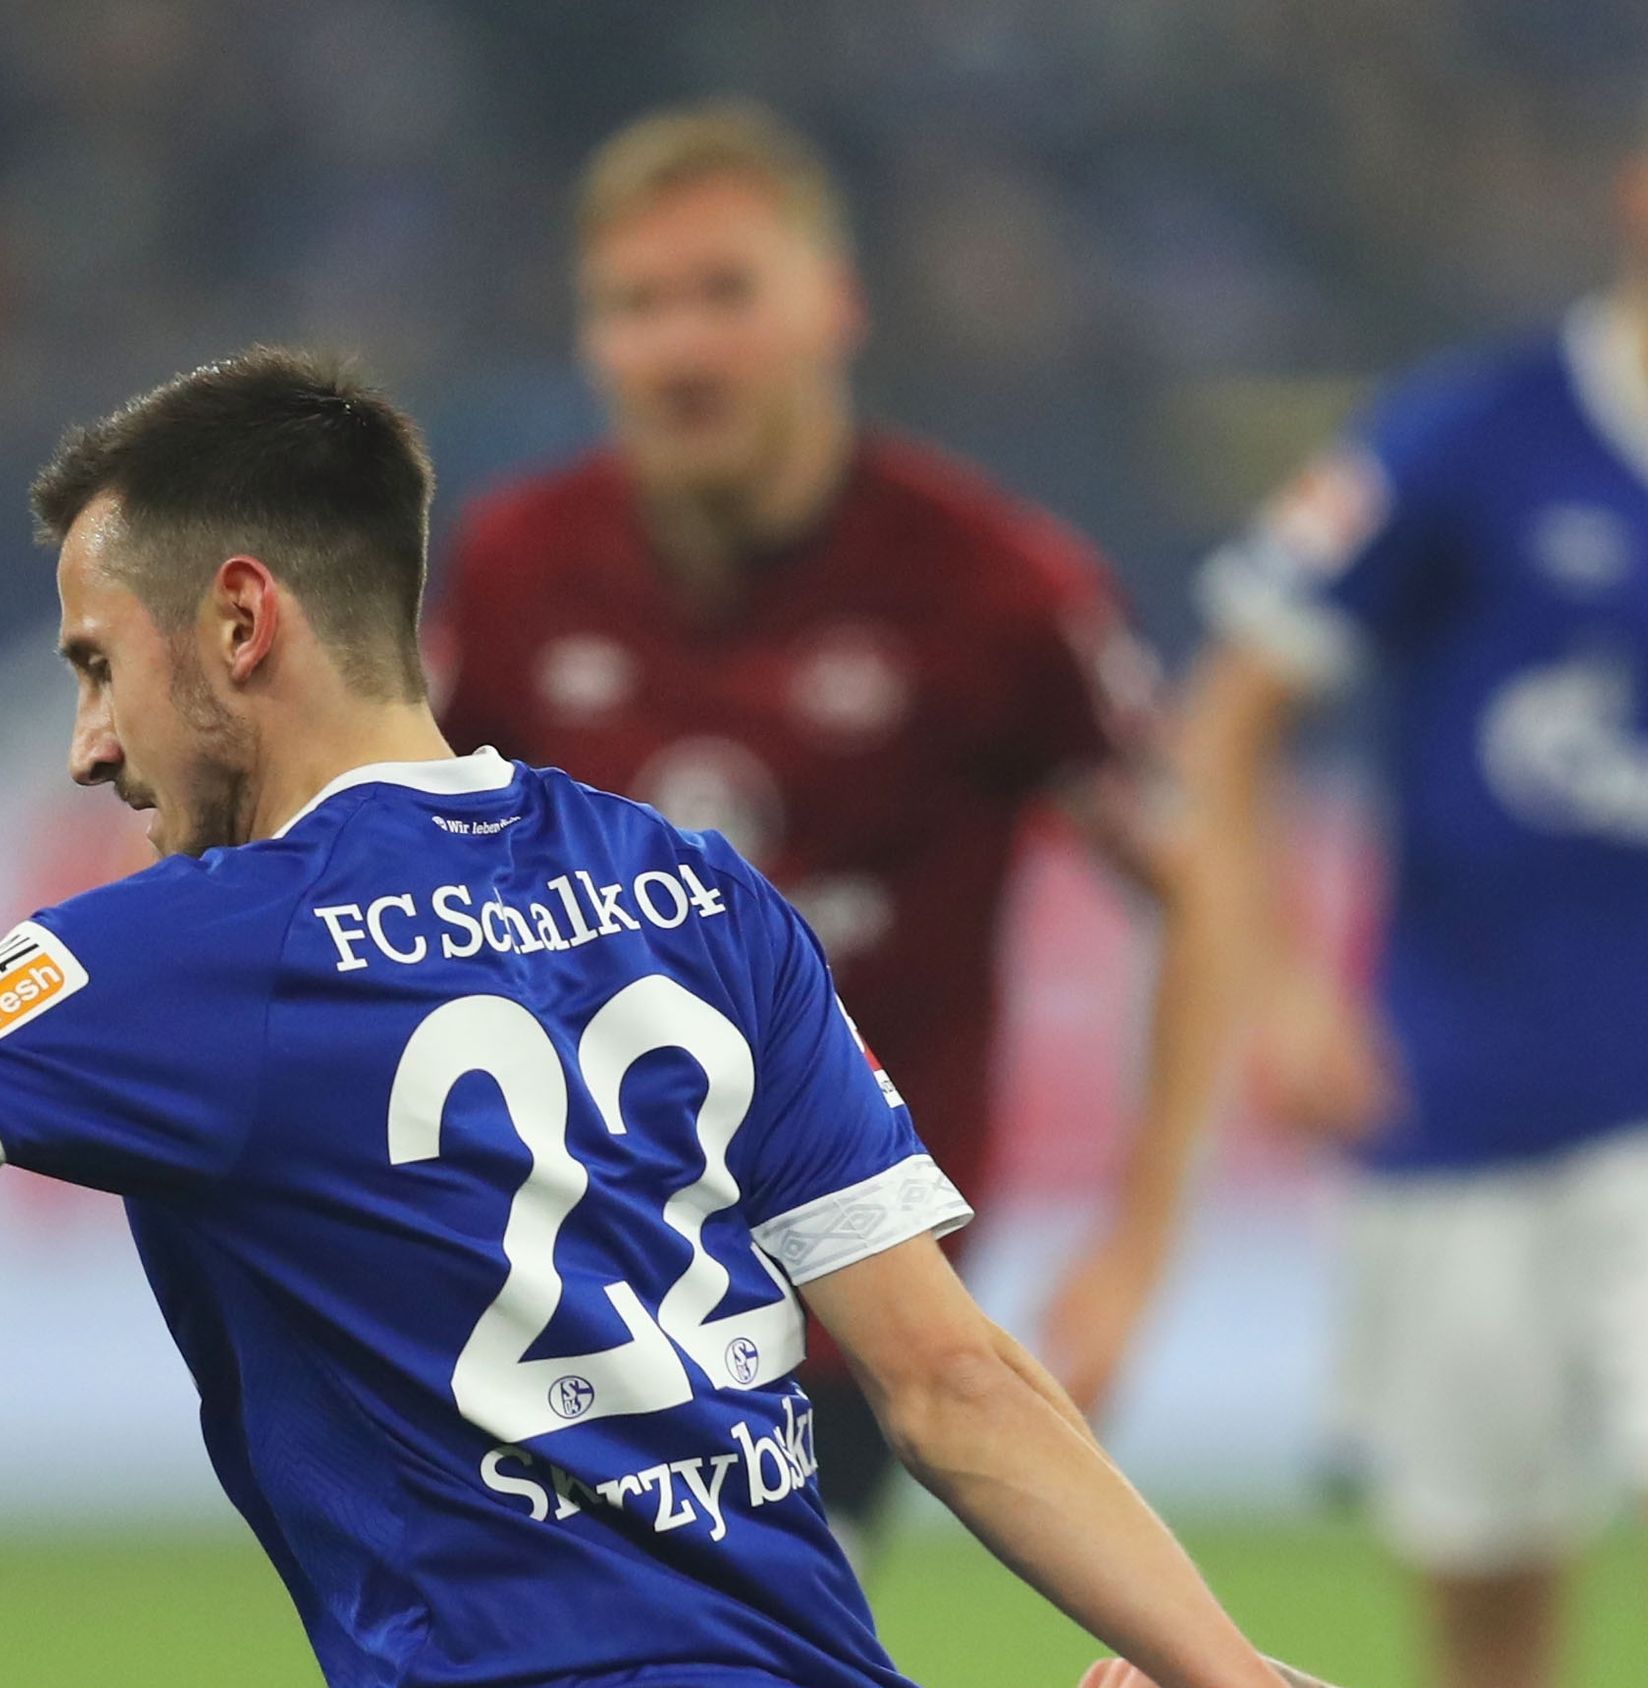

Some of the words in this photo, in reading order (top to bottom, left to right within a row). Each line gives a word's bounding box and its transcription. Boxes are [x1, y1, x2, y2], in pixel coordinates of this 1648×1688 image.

[447, 819, 470, 834] Wir
[472, 821, 501, 835] leben
[313, 894, 427, 972] FC
[387, 974, 806, 1443] 22
